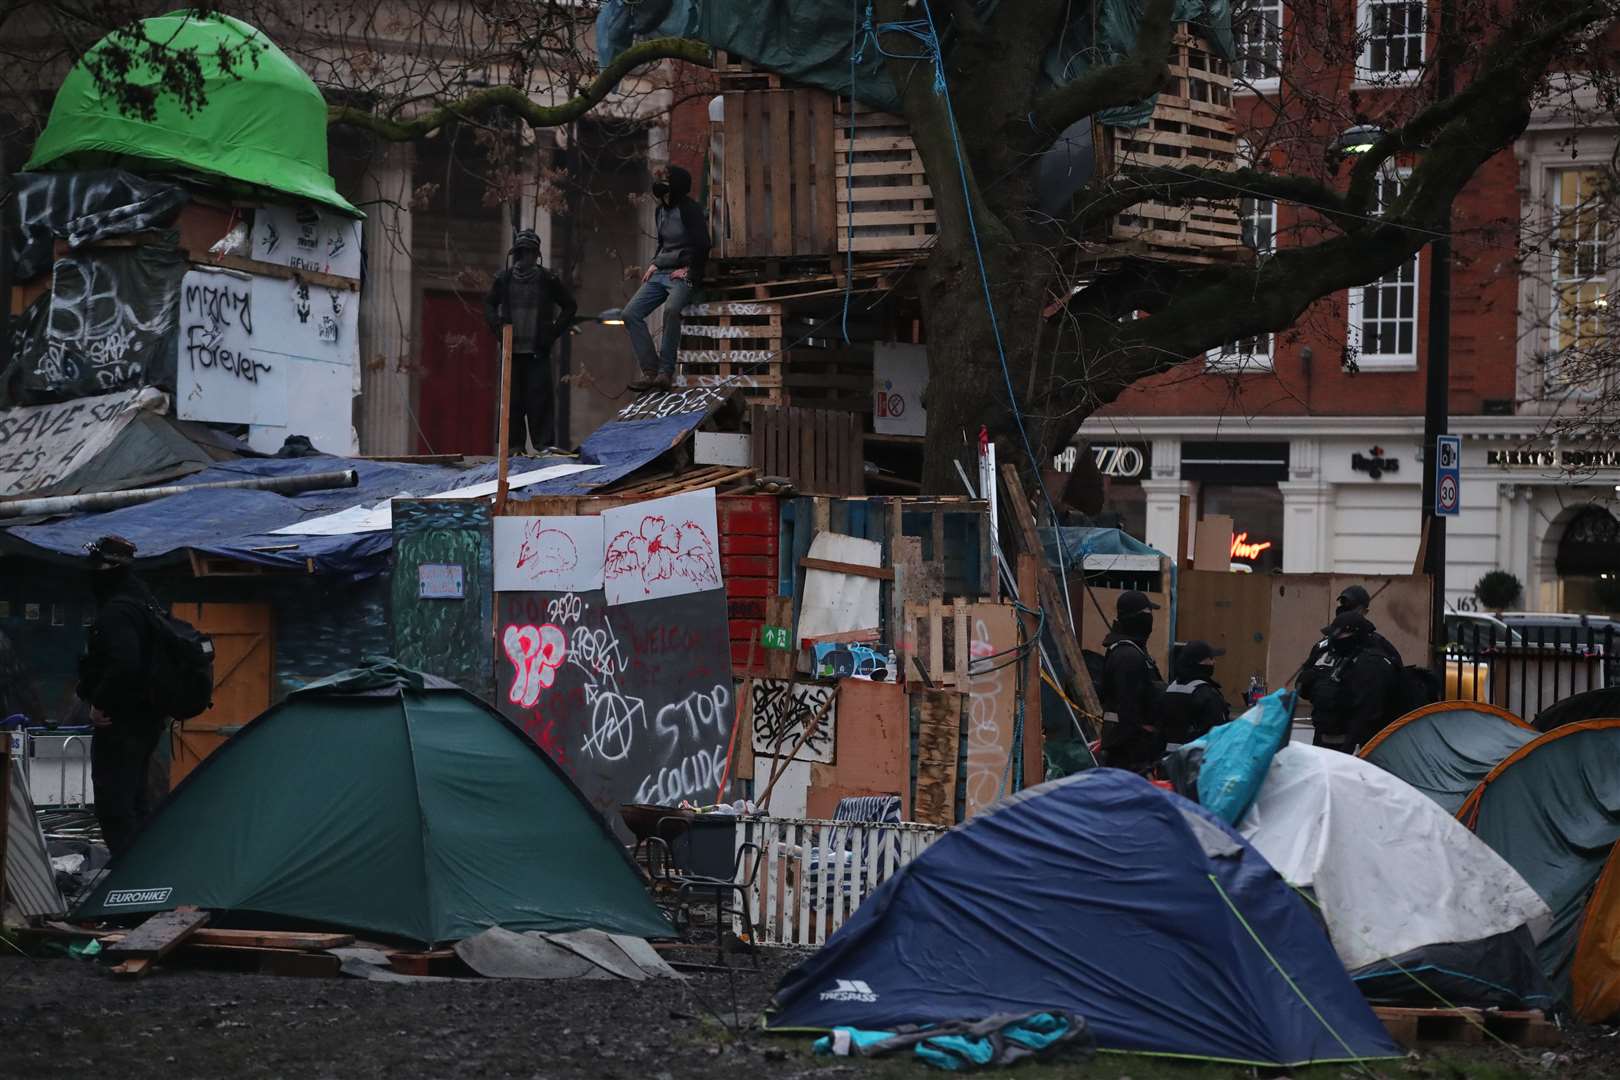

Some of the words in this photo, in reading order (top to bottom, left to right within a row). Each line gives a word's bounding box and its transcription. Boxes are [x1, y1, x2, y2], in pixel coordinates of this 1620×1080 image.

[187, 325, 271, 384] Forever
[0, 404, 85, 445] SAVE
[1441, 485, 1456, 501] 30
[656, 684, 729, 750] STOP
[635, 745, 731, 806] ECOCIDE
[109, 891, 167, 903] EUROHIKE
[819, 991, 877, 1002] TRESPASS
